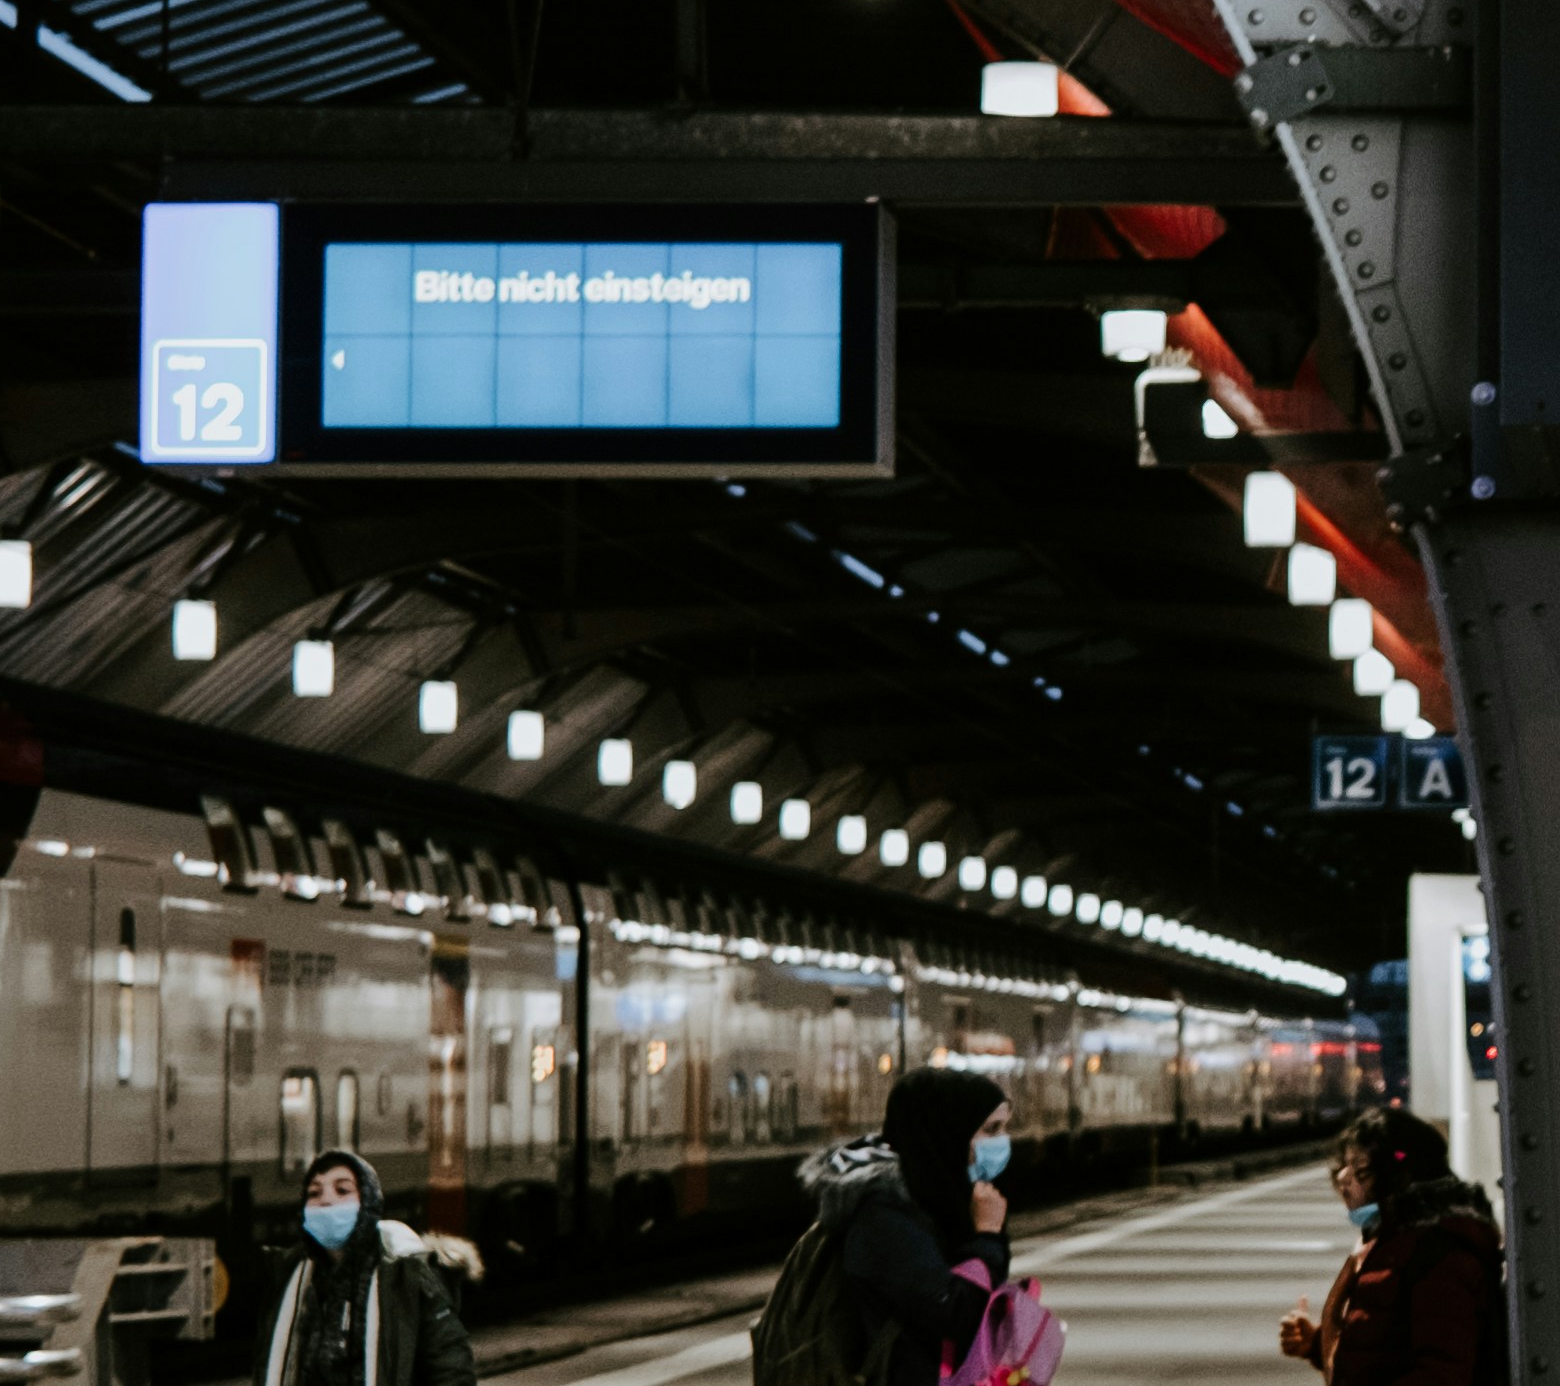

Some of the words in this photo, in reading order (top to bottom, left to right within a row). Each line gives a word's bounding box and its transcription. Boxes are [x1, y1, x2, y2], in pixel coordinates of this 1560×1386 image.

[416, 270, 495, 303] Bitte
[500, 270, 581, 303] nicht
[584, 270, 750, 310] einsteigen
[172, 381, 244, 441] 12
[1324, 757, 1375, 800] 12
[1419, 758, 1452, 798] A
